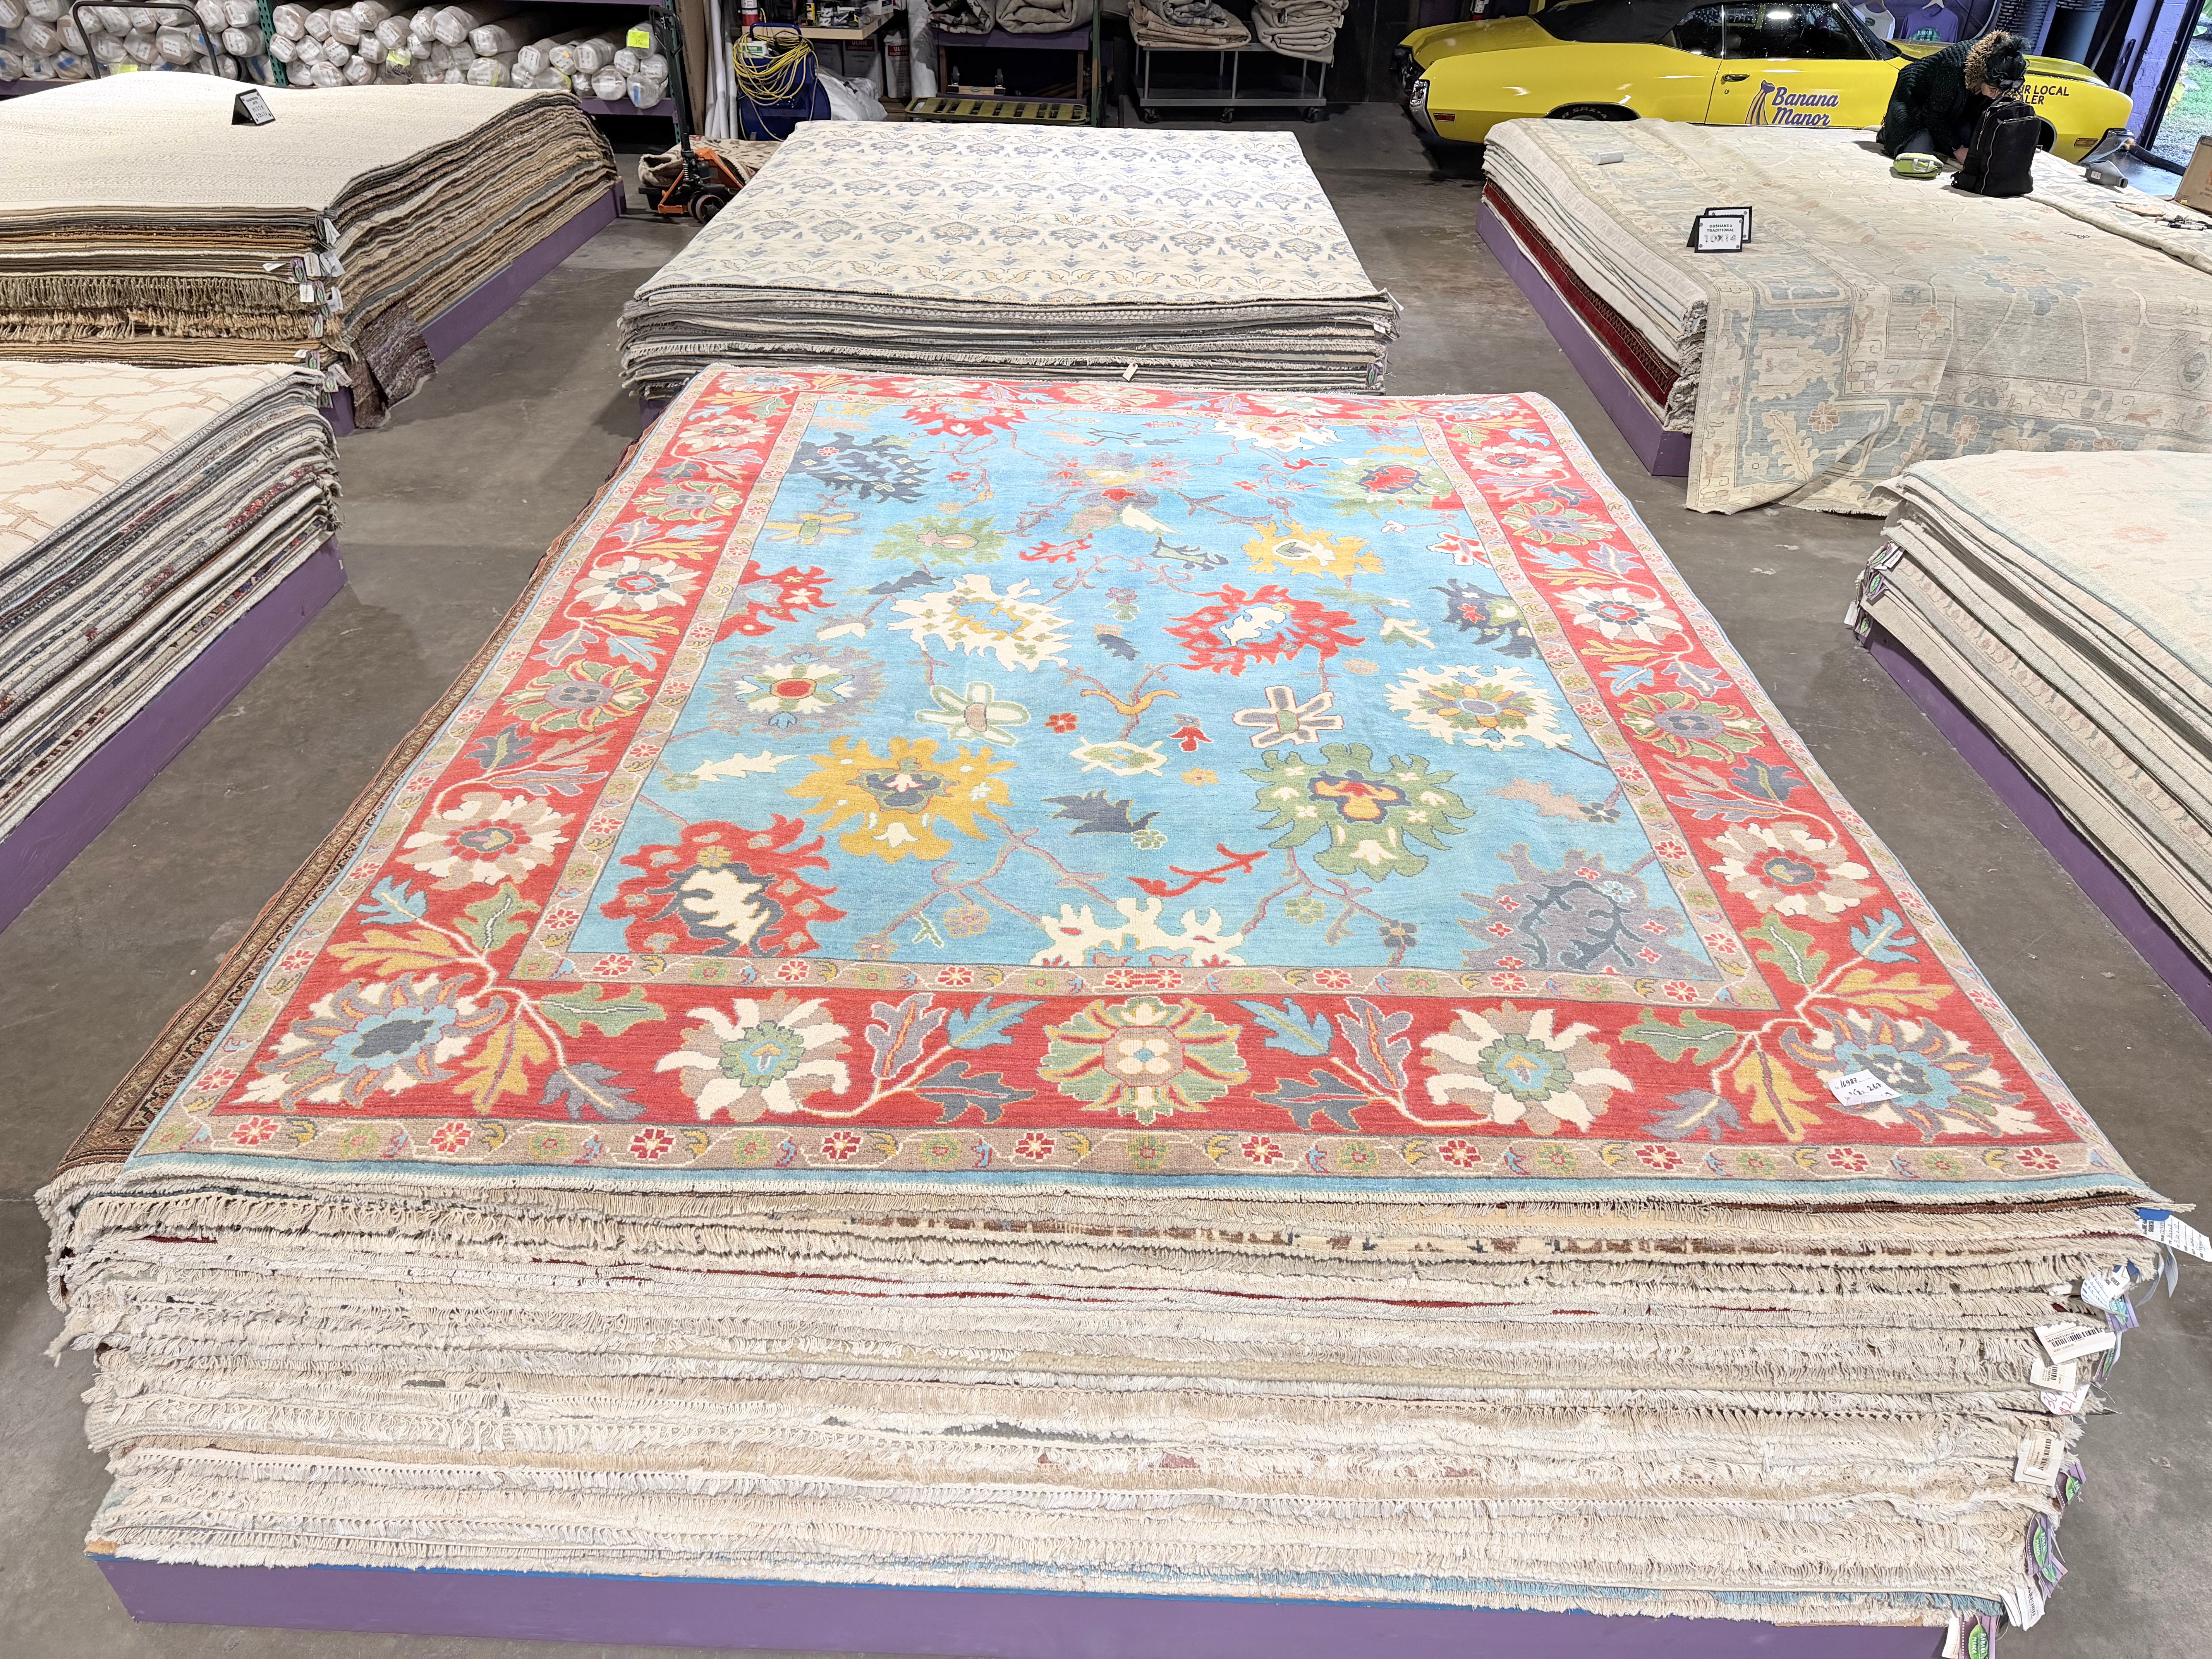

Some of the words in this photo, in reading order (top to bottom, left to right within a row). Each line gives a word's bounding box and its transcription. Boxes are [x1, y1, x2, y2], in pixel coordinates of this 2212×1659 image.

[1771, 87, 1839, 107] Banana
[2033, 85, 2069, 96] LOCAL
[1771, 106, 1831, 126] Manor
[1704, 234, 1736, 243] 10X14
